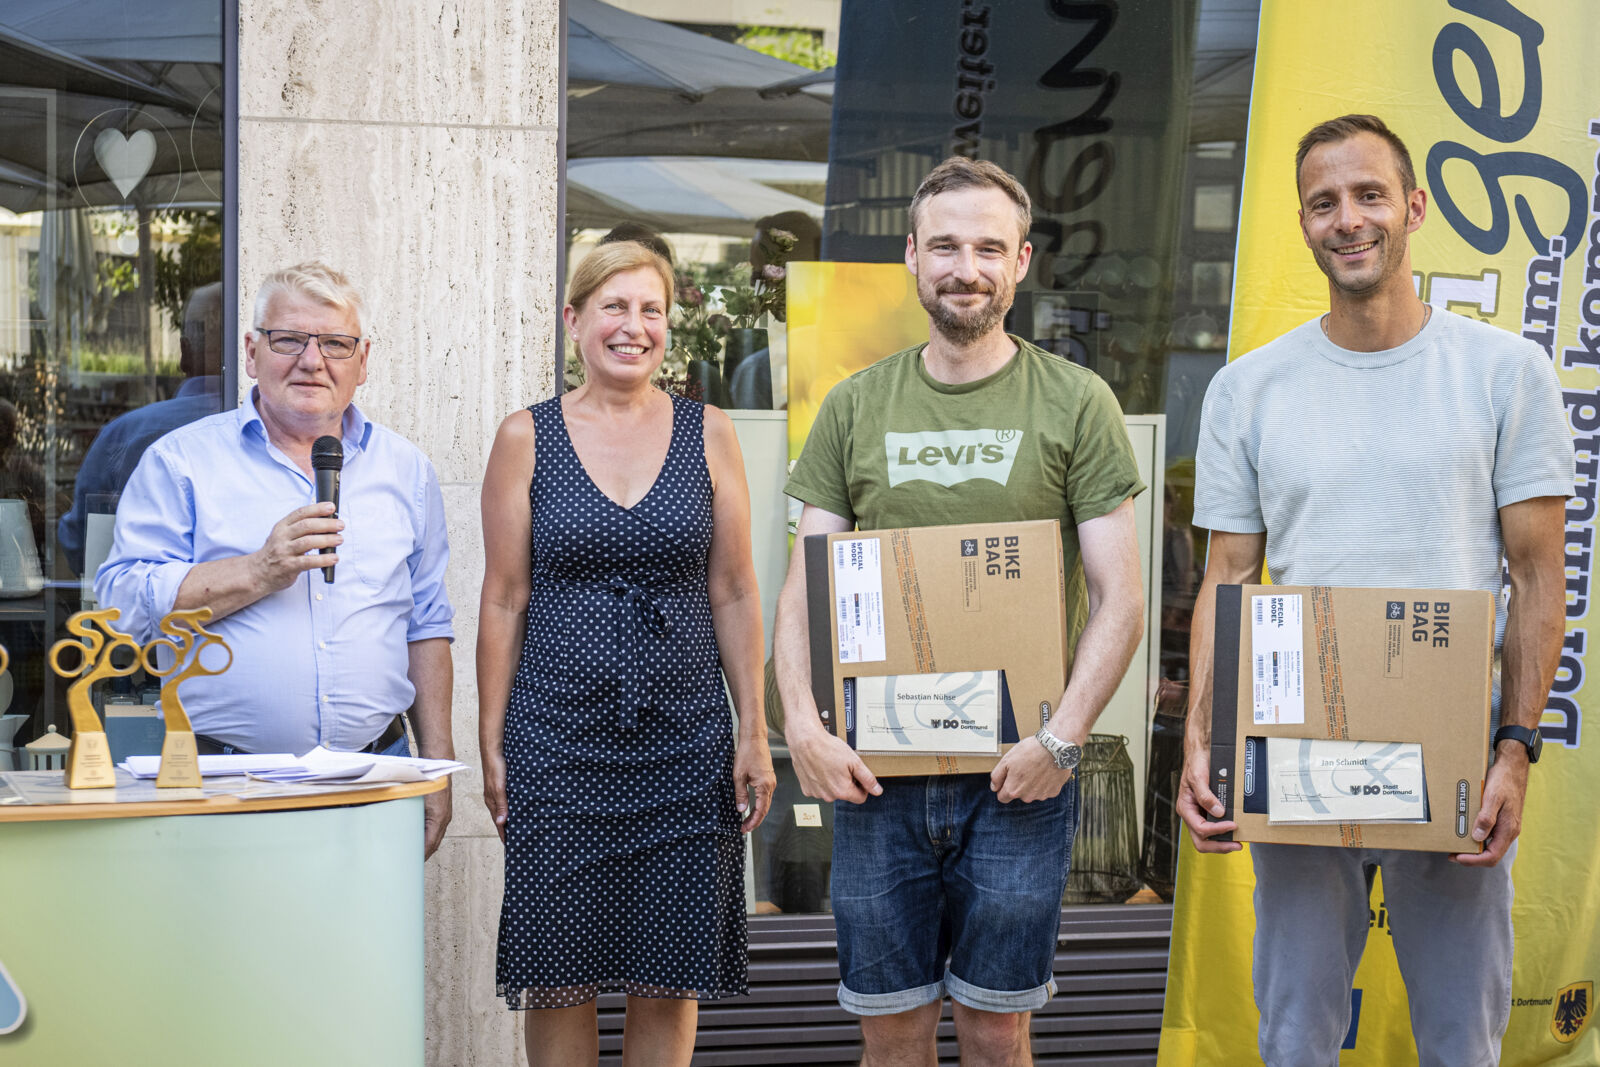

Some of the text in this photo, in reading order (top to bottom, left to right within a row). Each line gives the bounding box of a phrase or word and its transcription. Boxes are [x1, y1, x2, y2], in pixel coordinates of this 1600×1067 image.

[985, 537, 1001, 576] BAG
[1004, 536, 1020, 580] BIKE
[1412, 601, 1429, 642] BAG
[1433, 602, 1450, 648] BIKE
[897, 693, 957, 701] Sebastian Nühse
[943, 720, 959, 729] DO
[1321, 758, 1368, 767] Jan Schmidt
[1363, 785, 1380, 795] DO
[1517, 996, 1553, 1007] Dortmund
